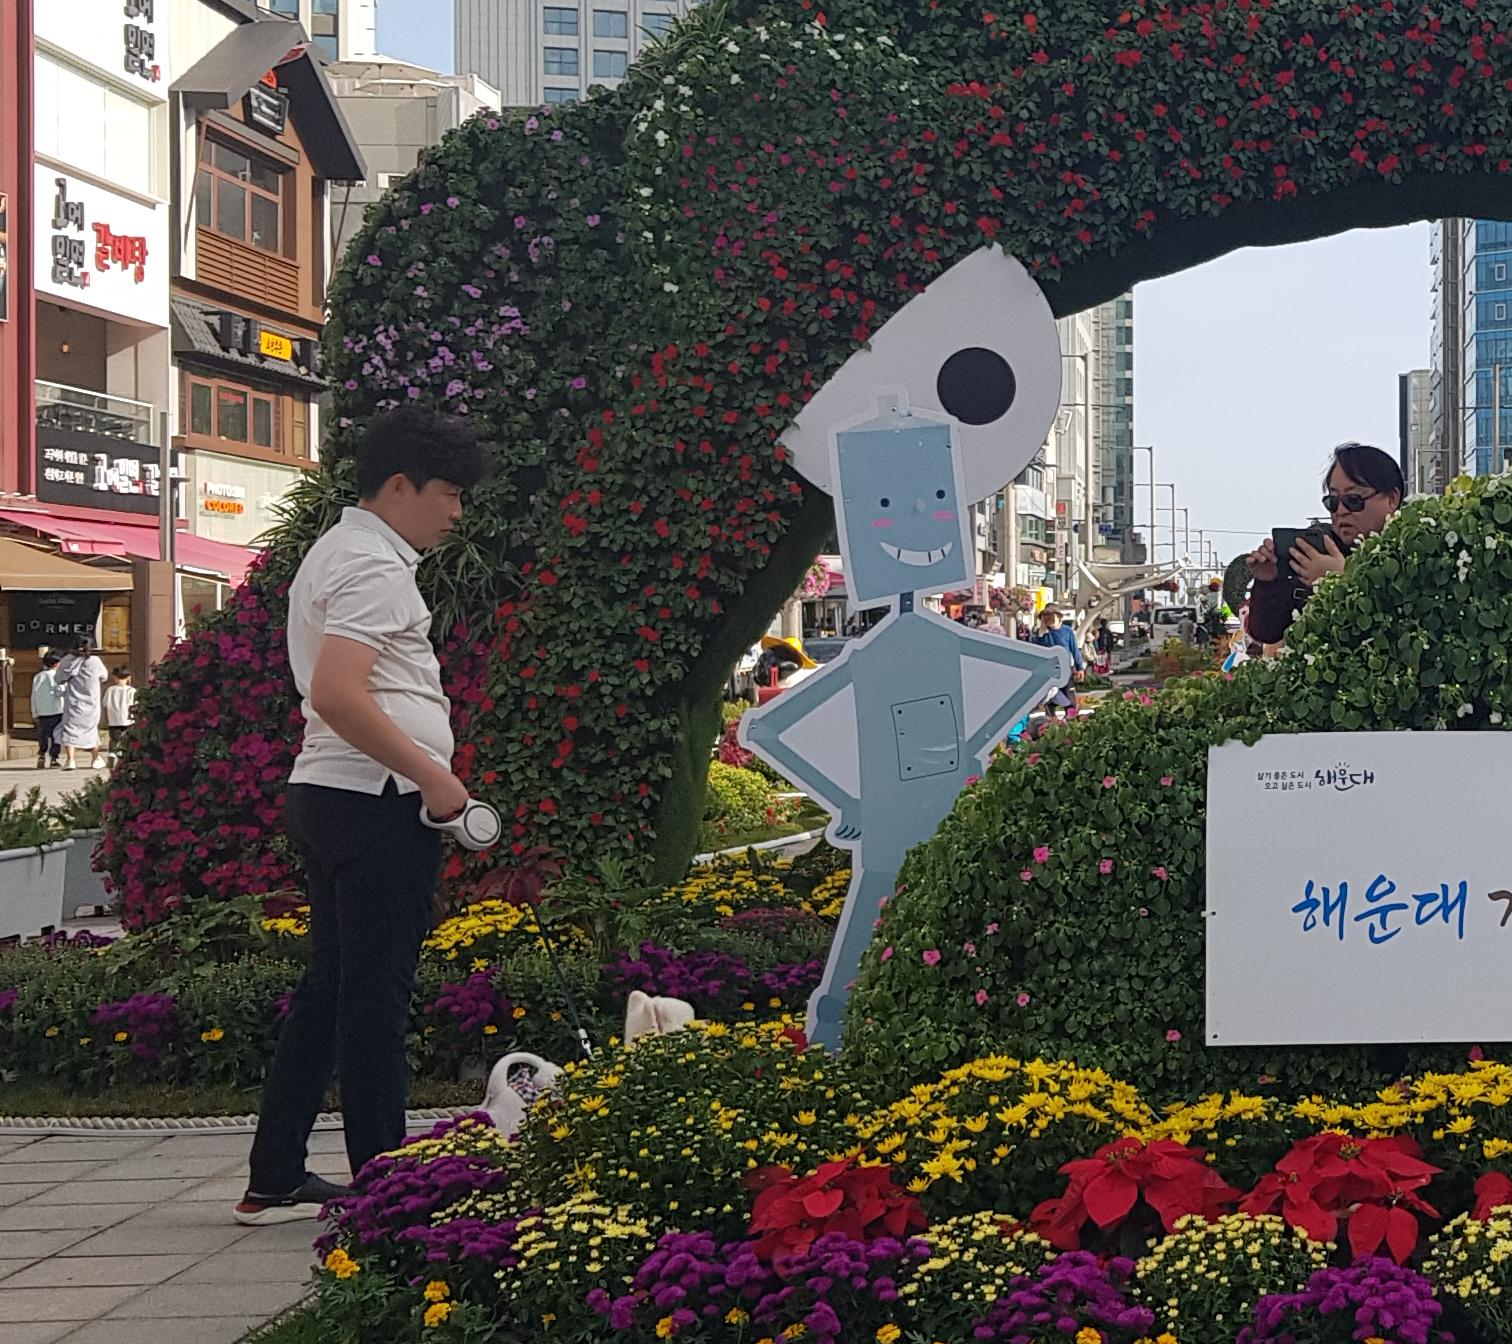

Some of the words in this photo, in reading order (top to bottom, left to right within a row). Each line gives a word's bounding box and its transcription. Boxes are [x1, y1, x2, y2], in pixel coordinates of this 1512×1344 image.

[91, 222, 149, 285] 갈비탕
[1289, 771, 1305, 779] 도시
[1314, 769, 1375, 791] 해운대
[1291, 873, 1468, 945] 해운대
